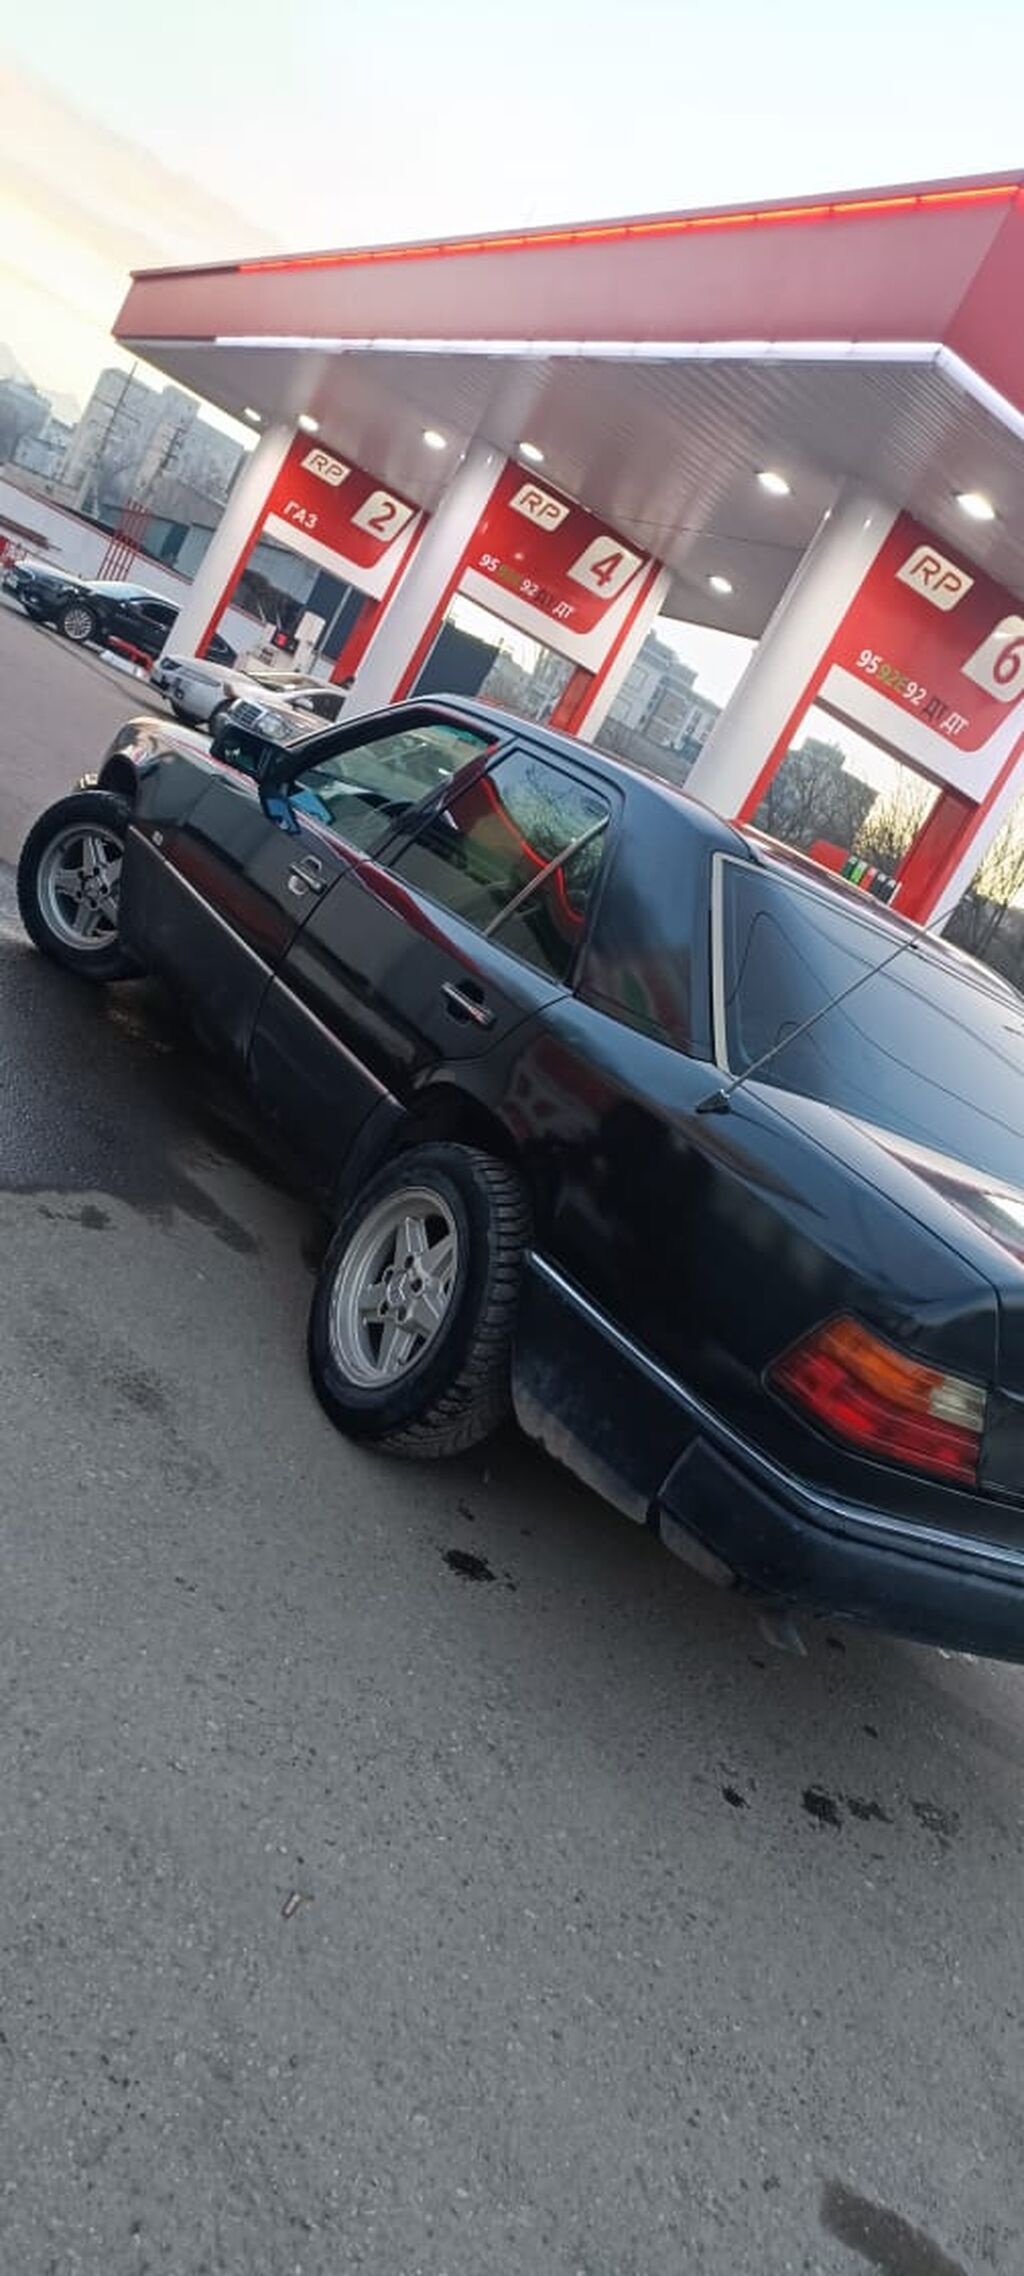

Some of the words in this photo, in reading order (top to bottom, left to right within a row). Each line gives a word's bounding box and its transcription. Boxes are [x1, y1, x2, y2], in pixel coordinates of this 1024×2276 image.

[309, 454, 343, 477] RP
[283, 501, 318, 529] ГАЗ
[368, 501, 397, 532] 2
[519, 491, 561, 519] RP
[478, 553, 501, 573] 95
[519, 578, 540, 597] 92
[590, 551, 624, 586] 4
[910, 555, 962, 593] RP
[993, 636, 1024, 685] 6
[856, 649, 882, 674] 95
[902, 681, 927, 706] 92
[939, 712, 969, 736] ДТ
